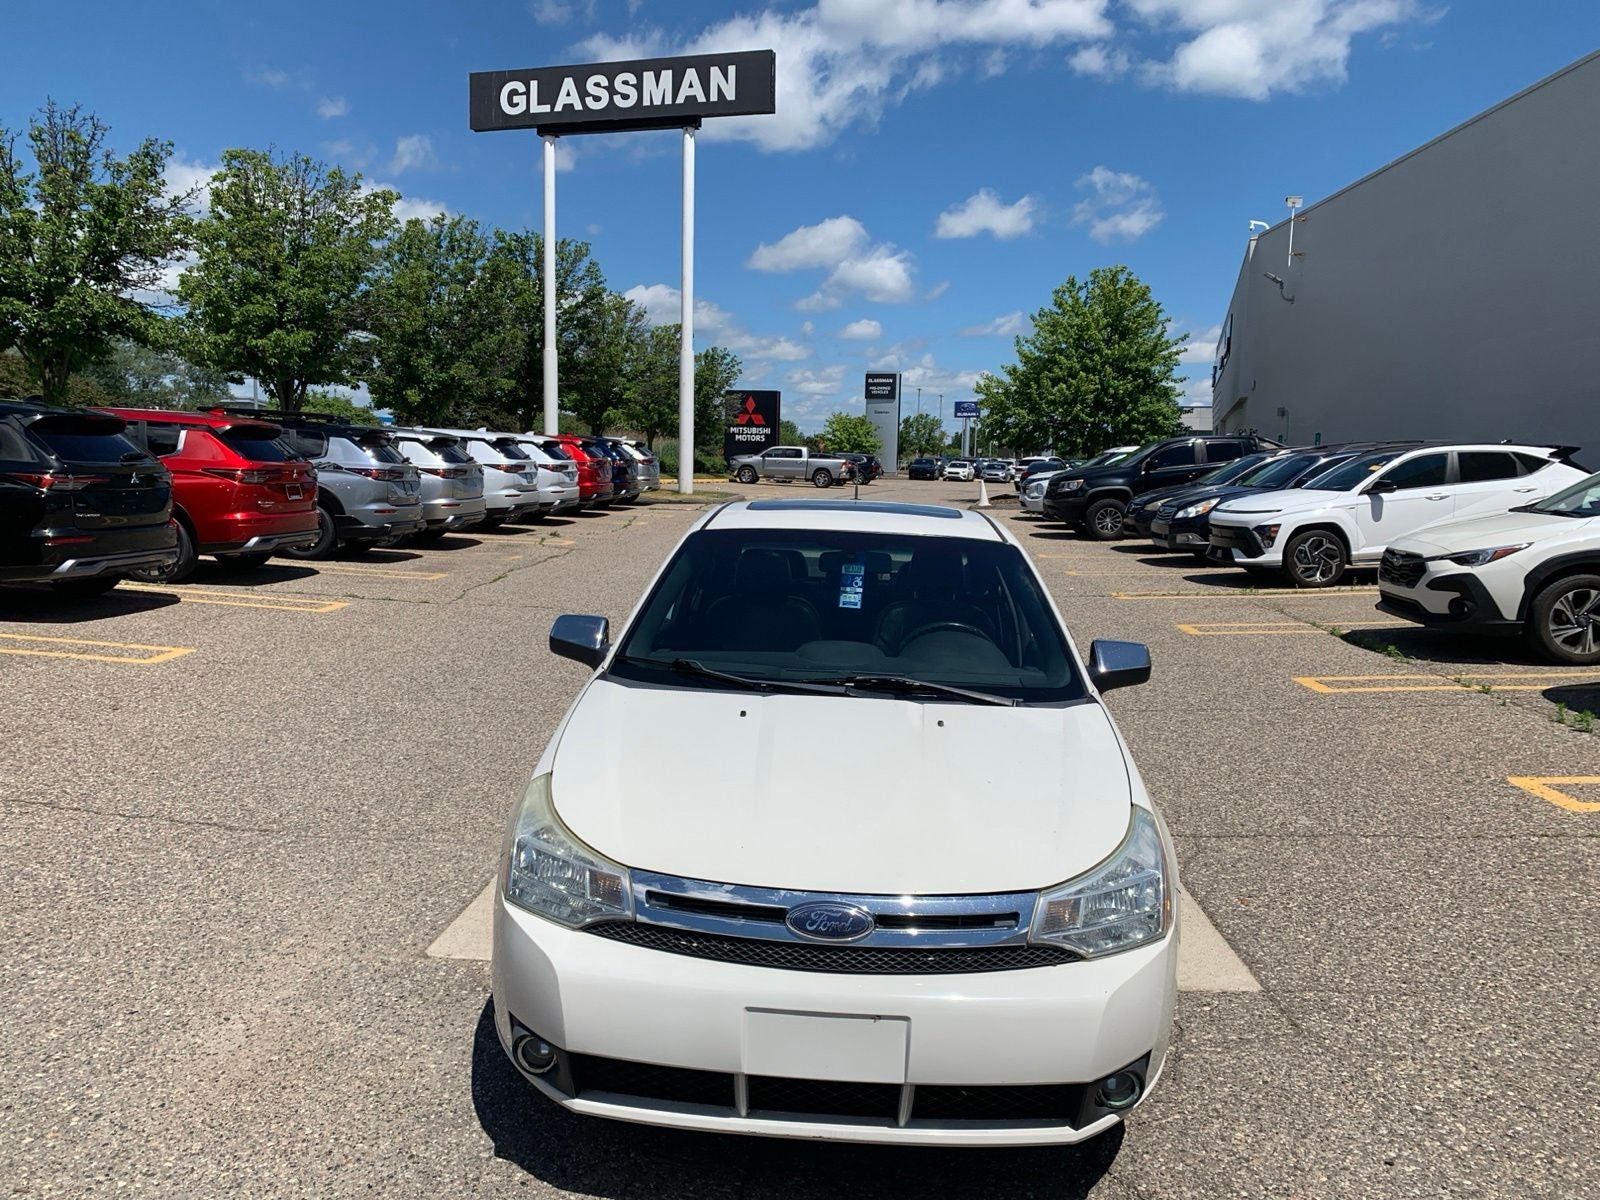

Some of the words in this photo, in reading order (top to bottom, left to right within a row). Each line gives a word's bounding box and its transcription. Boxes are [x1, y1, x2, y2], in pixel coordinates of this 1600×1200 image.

[499, 64, 736, 115] GLASSMAN
[730, 426, 771, 434] MITSUBISHI
[735, 434, 766, 442] MOTORS
[805, 910, 854, 932] Ford
